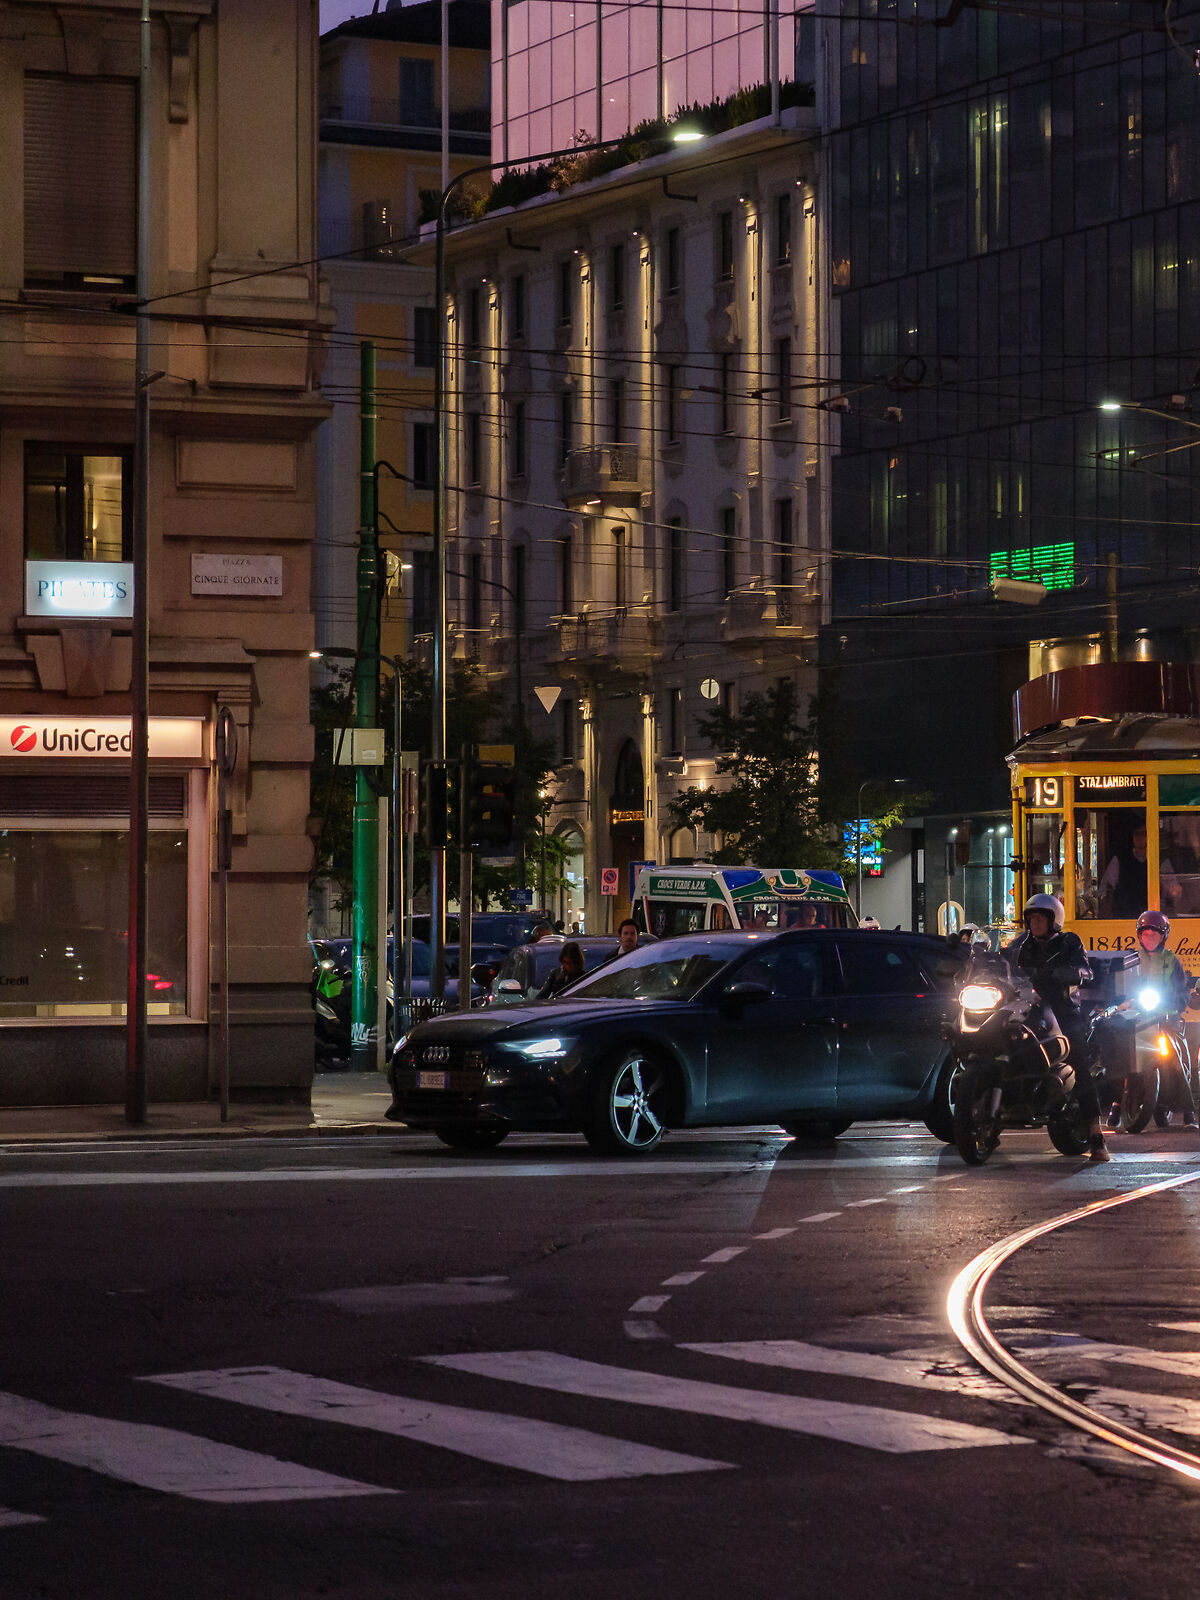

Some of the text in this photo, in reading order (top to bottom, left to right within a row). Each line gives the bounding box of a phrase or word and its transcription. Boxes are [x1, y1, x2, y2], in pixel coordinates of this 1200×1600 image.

[194, 575, 279, 585] CINQUE GIORNATE
[38, 580, 128, 599] PILTES
[42, 727, 149, 752] UniCred
[1035, 777, 1059, 806] 19
[656, 879, 674, 889] CROCE
[674, 880, 690, 890] VERDE
[1089, 936, 1136, 951] 1842
